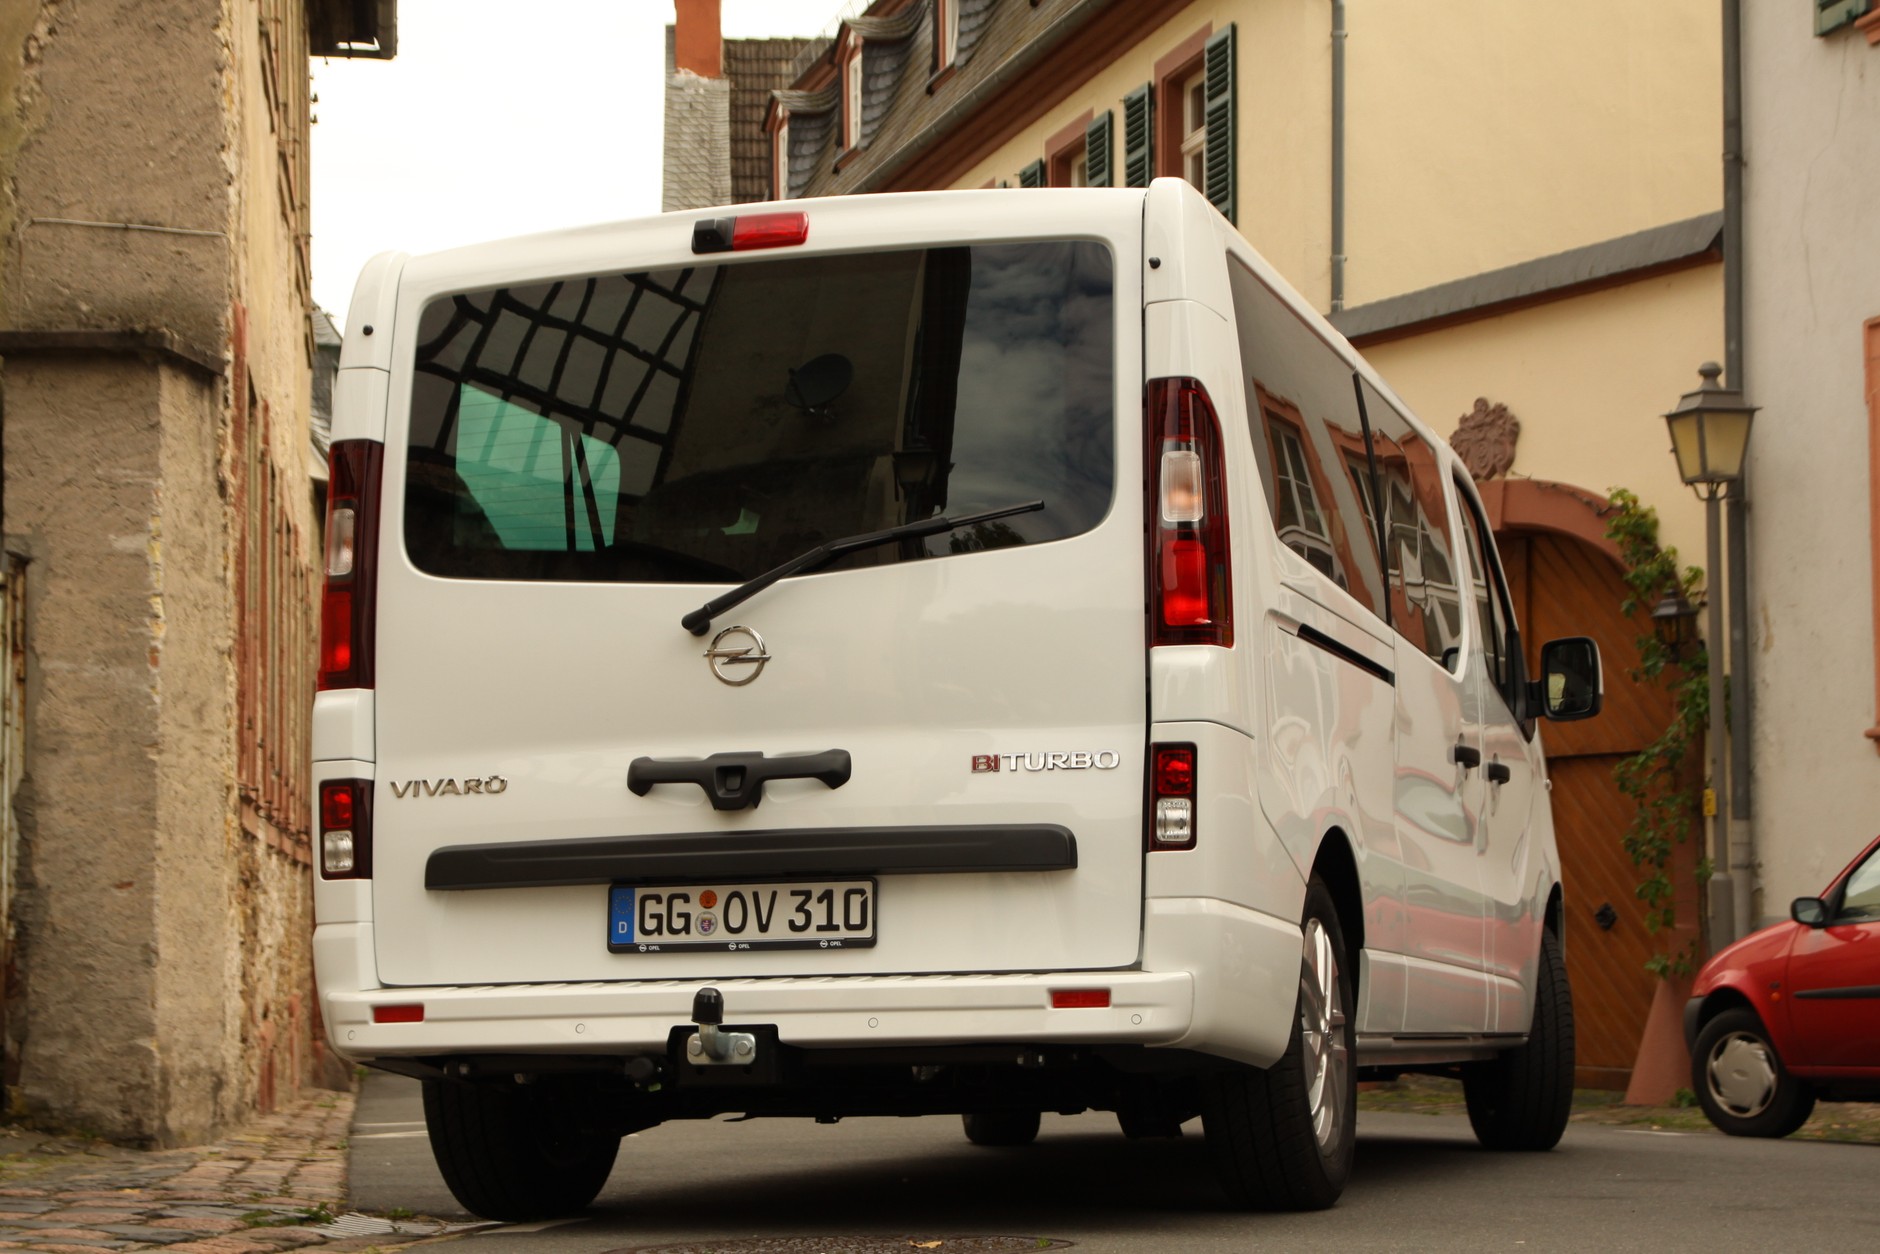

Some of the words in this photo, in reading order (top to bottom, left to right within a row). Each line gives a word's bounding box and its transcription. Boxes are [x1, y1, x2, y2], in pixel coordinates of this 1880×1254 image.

[389, 775, 508, 799] VIVARO
[638, 893, 691, 936] GG
[723, 890, 778, 934] OV
[788, 888, 869, 932] 310
[618, 921, 628, 934] D
